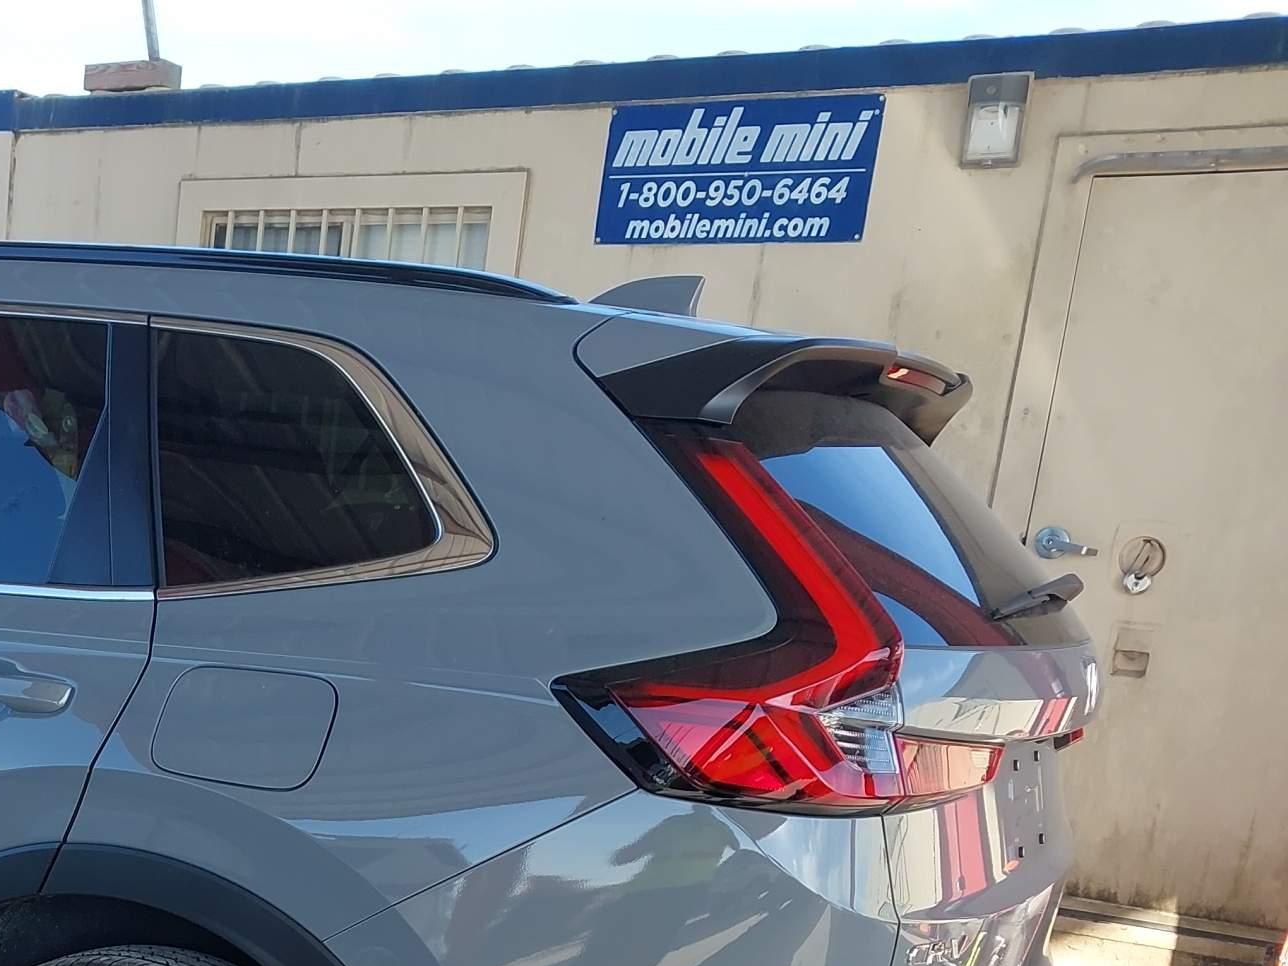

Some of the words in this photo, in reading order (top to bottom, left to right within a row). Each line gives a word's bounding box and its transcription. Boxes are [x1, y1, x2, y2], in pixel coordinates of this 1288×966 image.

[612, 107, 761, 167] mobile
[760, 111, 873, 163] mini
[618, 177, 850, 208] 1-800-950-6464
[625, 213, 831, 239] mobilemini.com
